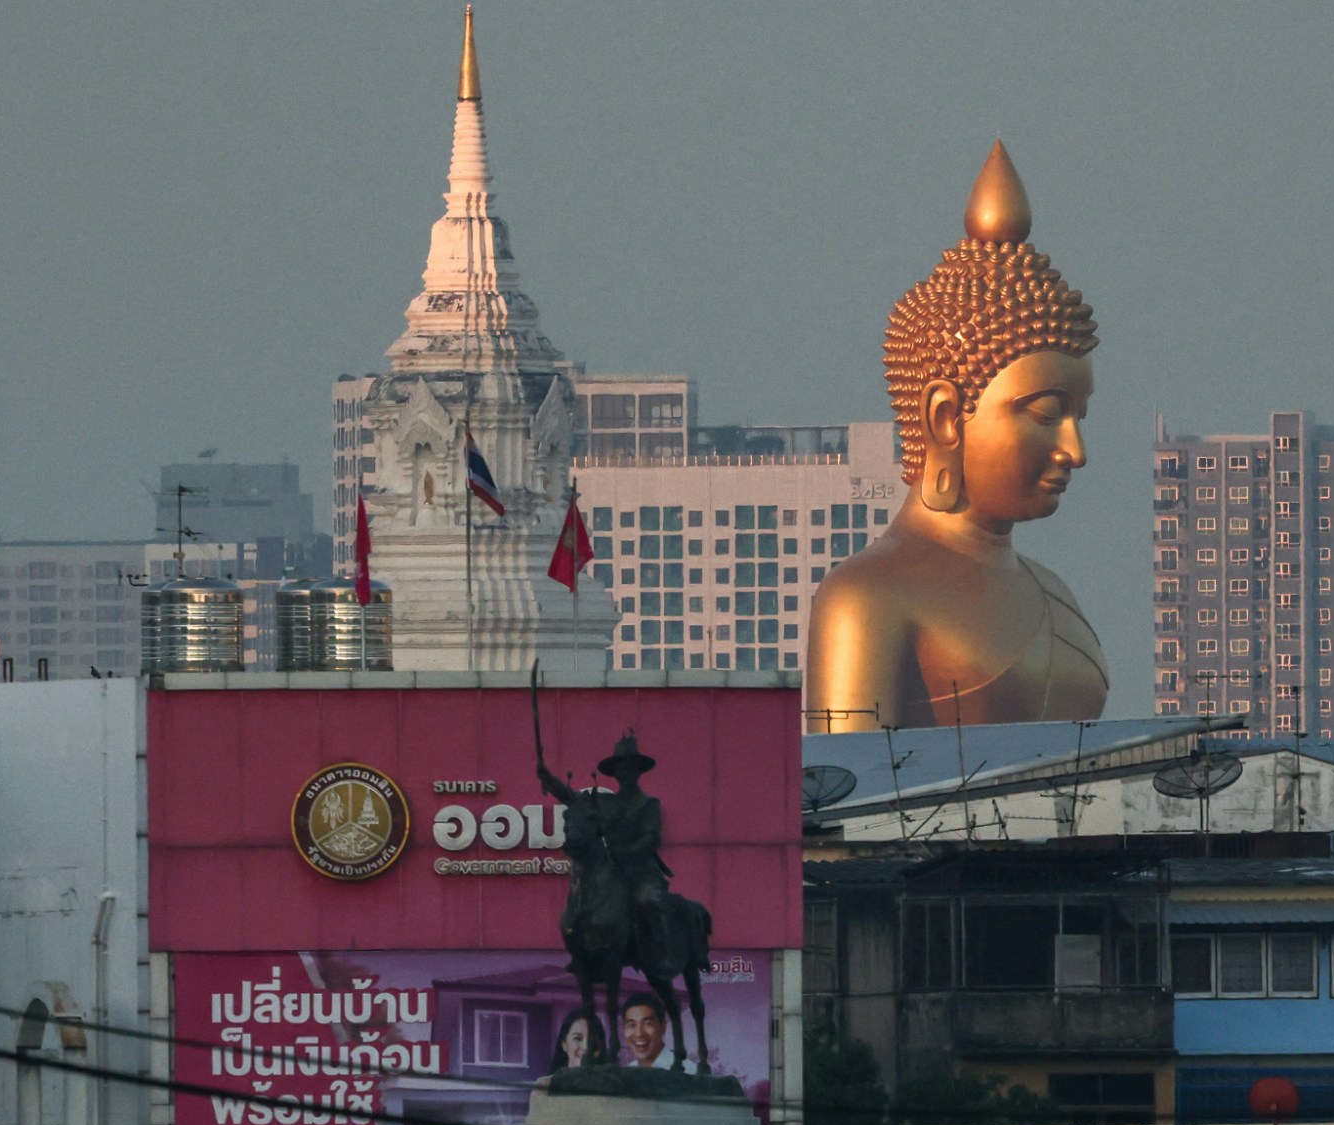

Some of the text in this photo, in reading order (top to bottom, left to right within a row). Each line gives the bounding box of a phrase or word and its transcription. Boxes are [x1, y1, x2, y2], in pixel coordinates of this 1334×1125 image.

[432, 780, 497, 793] ธนาคาร
[432, 855, 542, 876] Government
[701, 956, 754, 974] อมสิน
[211, 965, 428, 1024] เปลี่ยนบ้าน
[211, 1026, 441, 1077] เป็นเงินก้อน
[210, 1079, 374, 1125] พร้อมใช้
